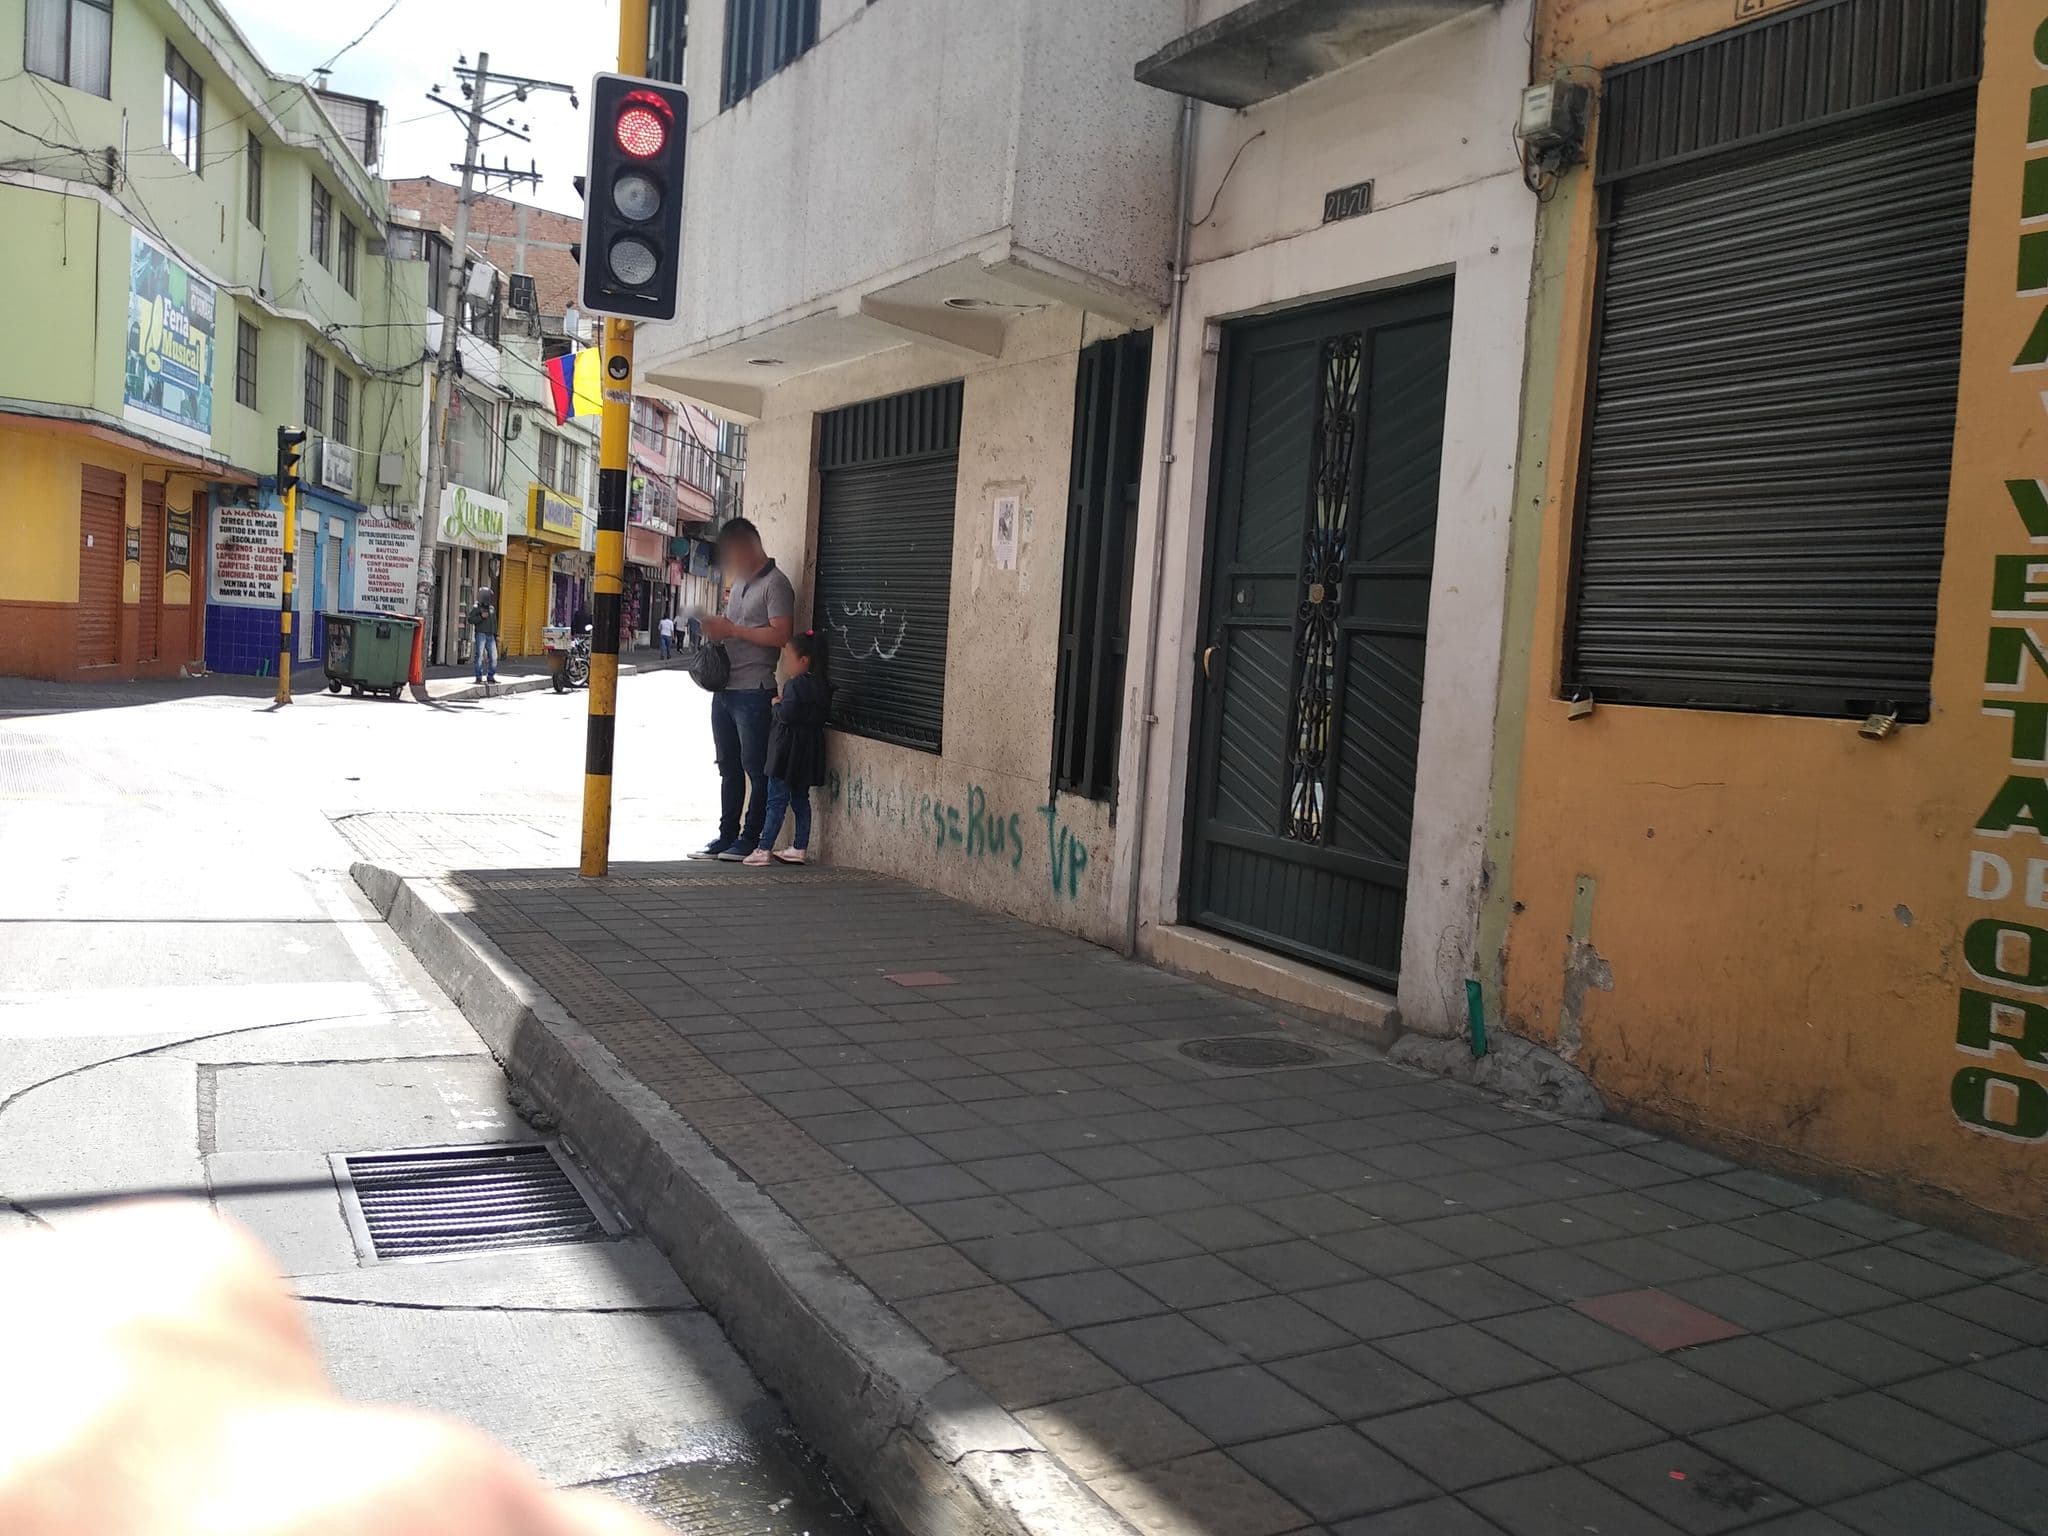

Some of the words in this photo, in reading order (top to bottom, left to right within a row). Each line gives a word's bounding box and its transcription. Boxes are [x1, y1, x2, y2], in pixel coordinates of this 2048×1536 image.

[164, 297, 190, 339] Feria
[163, 330, 200, 373] Musical
[234, 510, 277, 519] NACIONAL
[221, 518, 244, 526] OFRECE
[255, 520, 278, 528] MEJOR
[384, 520, 390, 528] LA
[220, 526, 246, 534] SURTIDO
[258, 528, 279, 536] UTILES
[232, 536, 268, 544] ESCOLARES
[216, 543, 253, 552] CURNOS
[258, 546, 283, 555] LAPICES
[216, 552, 250, 561] LAPICEROS
[254, 555, 282, 564] COLORES
[218, 561, 250, 570] CARPETAS
[254, 563, 278, 572] REGLAS
[218, 570, 254, 580] LONCHERAS
[224, 580, 247, 588] VENTAS
[248, 590, 257, 598] AL
[258, 591, 276, 599] DETAL
[362, 594, 379, 602] VENTAS
[1951, 918, 2048, 1144] ORO
